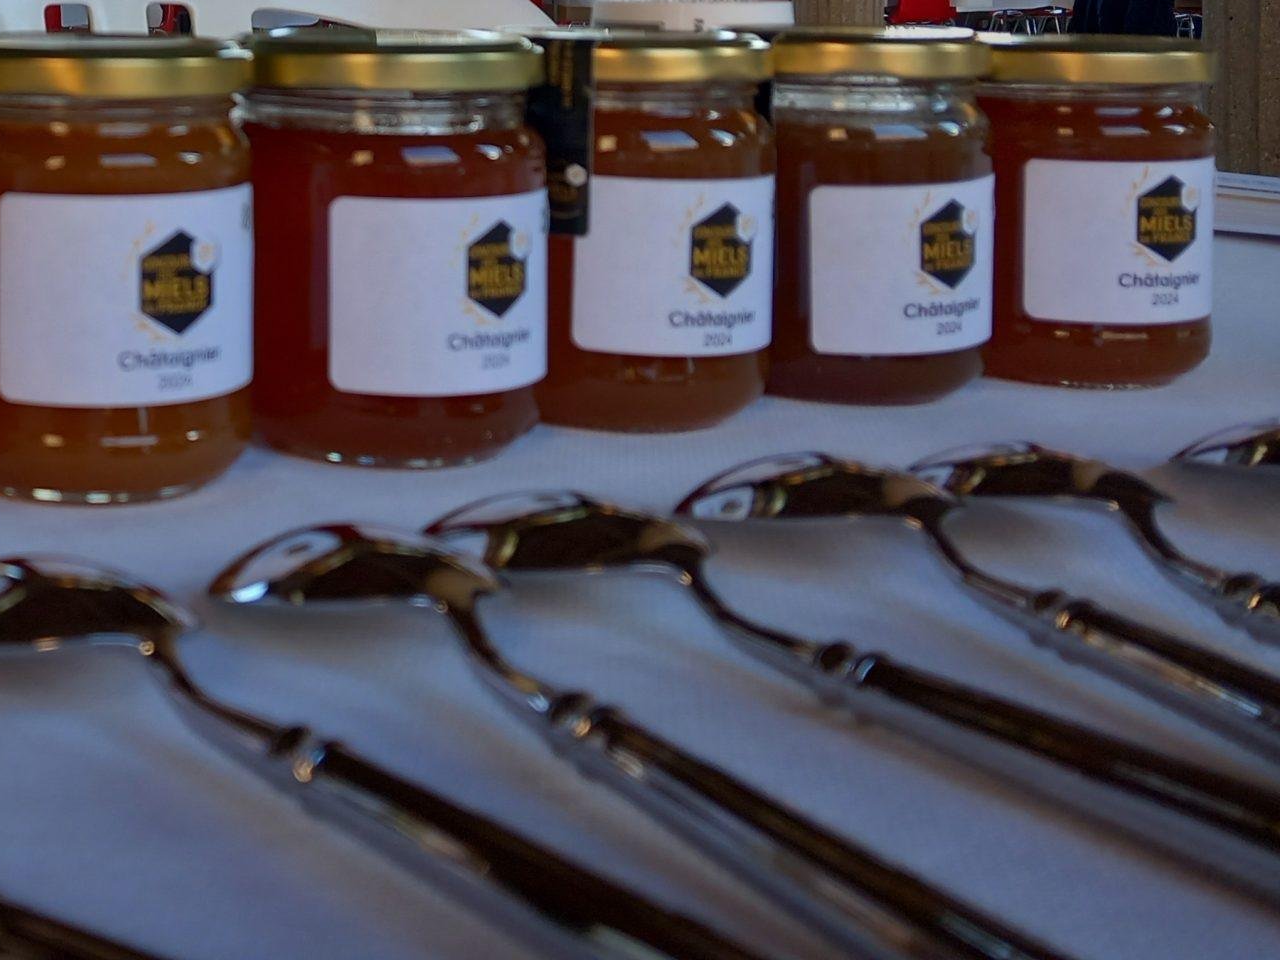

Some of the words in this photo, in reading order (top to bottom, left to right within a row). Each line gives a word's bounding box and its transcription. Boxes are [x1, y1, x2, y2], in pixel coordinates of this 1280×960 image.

[1141, 214, 1193, 234] MIELS
[693, 245, 747, 267] MIELS
[1118, 271, 1201, 290] Châtaignier
